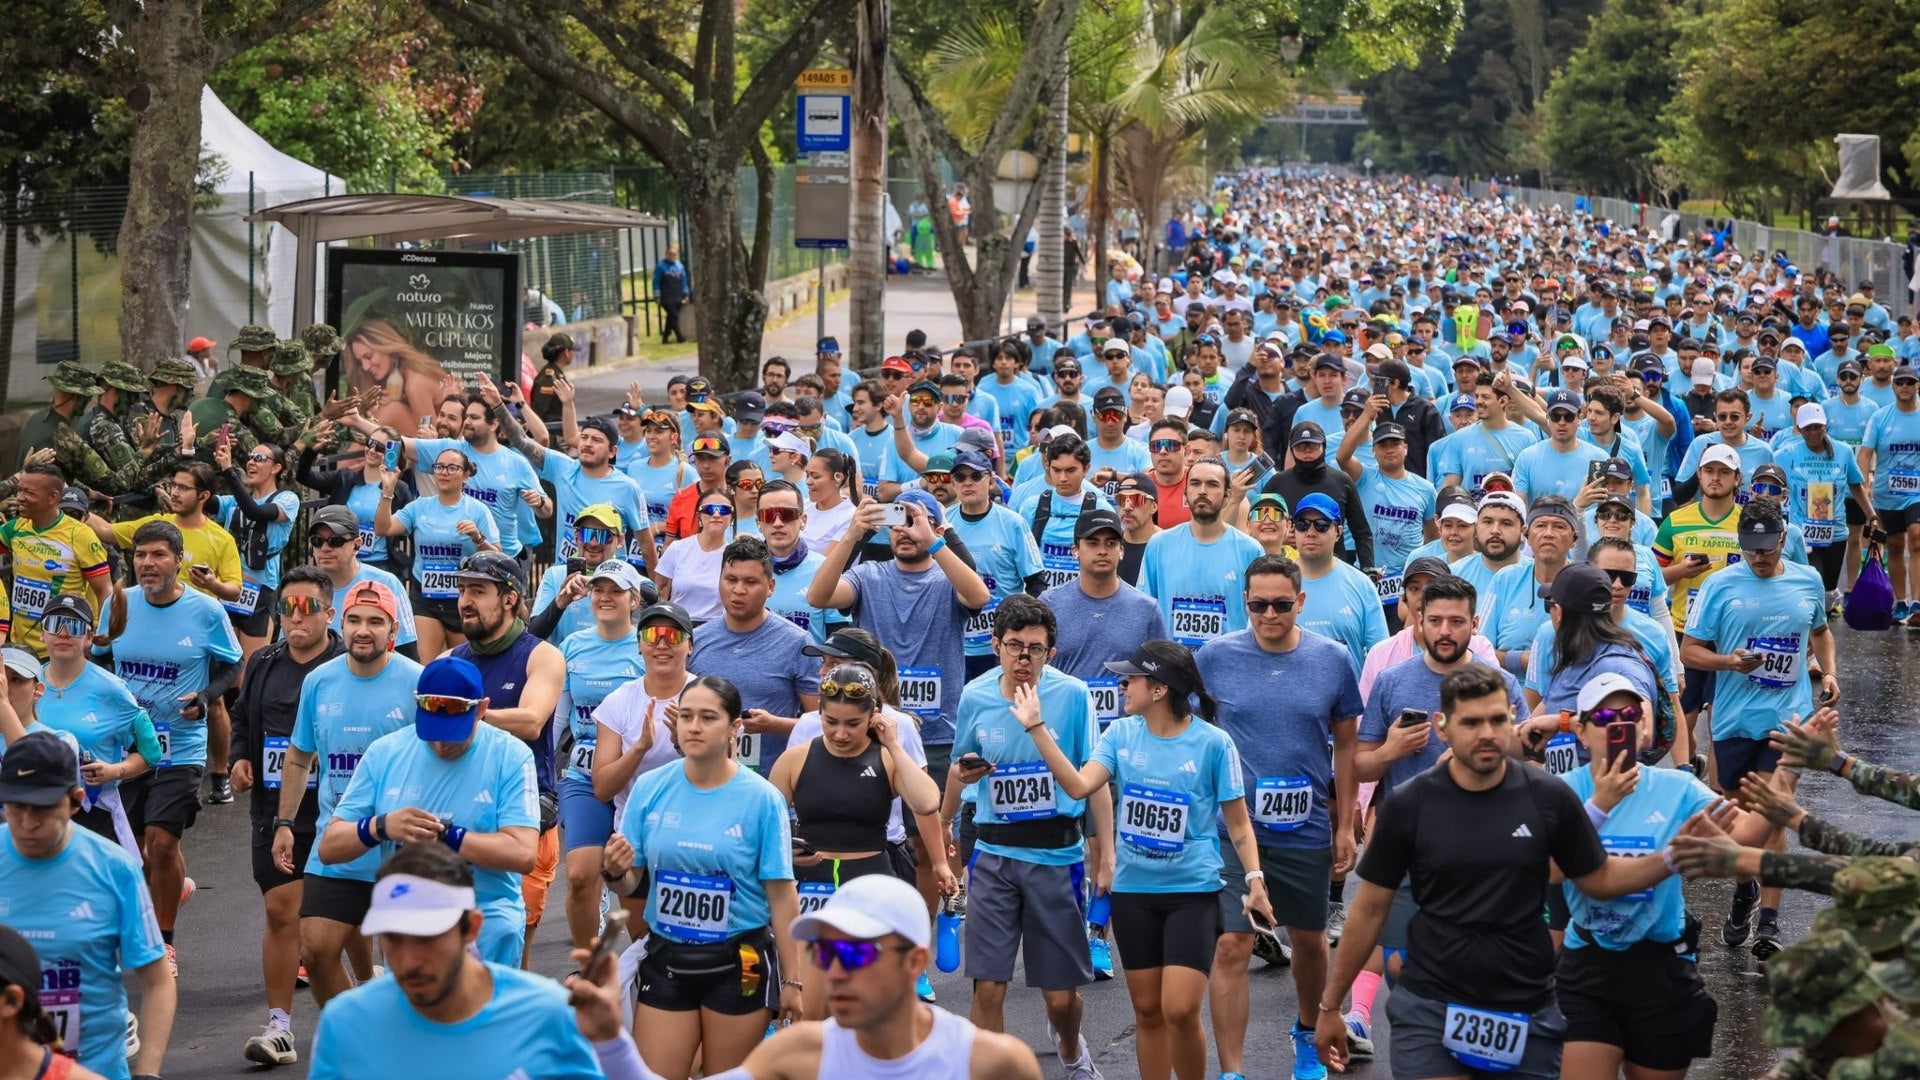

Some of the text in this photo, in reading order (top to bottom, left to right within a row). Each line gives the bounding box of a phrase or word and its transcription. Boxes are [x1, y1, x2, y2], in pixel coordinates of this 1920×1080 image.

[802, 73, 836, 83] 149A05
[401, 254, 437, 263] JCDecaux
[397, 292, 442, 303] natura
[469, 302, 494, 311] Nuevo
[405, 311, 495, 330] NATURA EKOS
[440, 360, 492, 370] visiblemente
[464, 351, 492, 361] Mejora
[1891, 476, 1918, 489] 25567
[1804, 526, 1832, 540] 23755
[420, 545, 462, 557] mmB
[14, 586, 46, 609] 19568
[966, 611, 997, 633] 2489
[1175, 612, 1220, 634] 23536
[121, 661, 179, 680] mmB
[898, 680, 937, 702] 4419
[994, 777, 1051, 805] 20234
[1143, 778, 1171, 786] SAMSUNG
[1262, 790, 1308, 817] 24418
[1126, 800, 1183, 834] 19653
[660, 888, 725, 922] 22060
[1451, 1011, 1521, 1054] 23387
